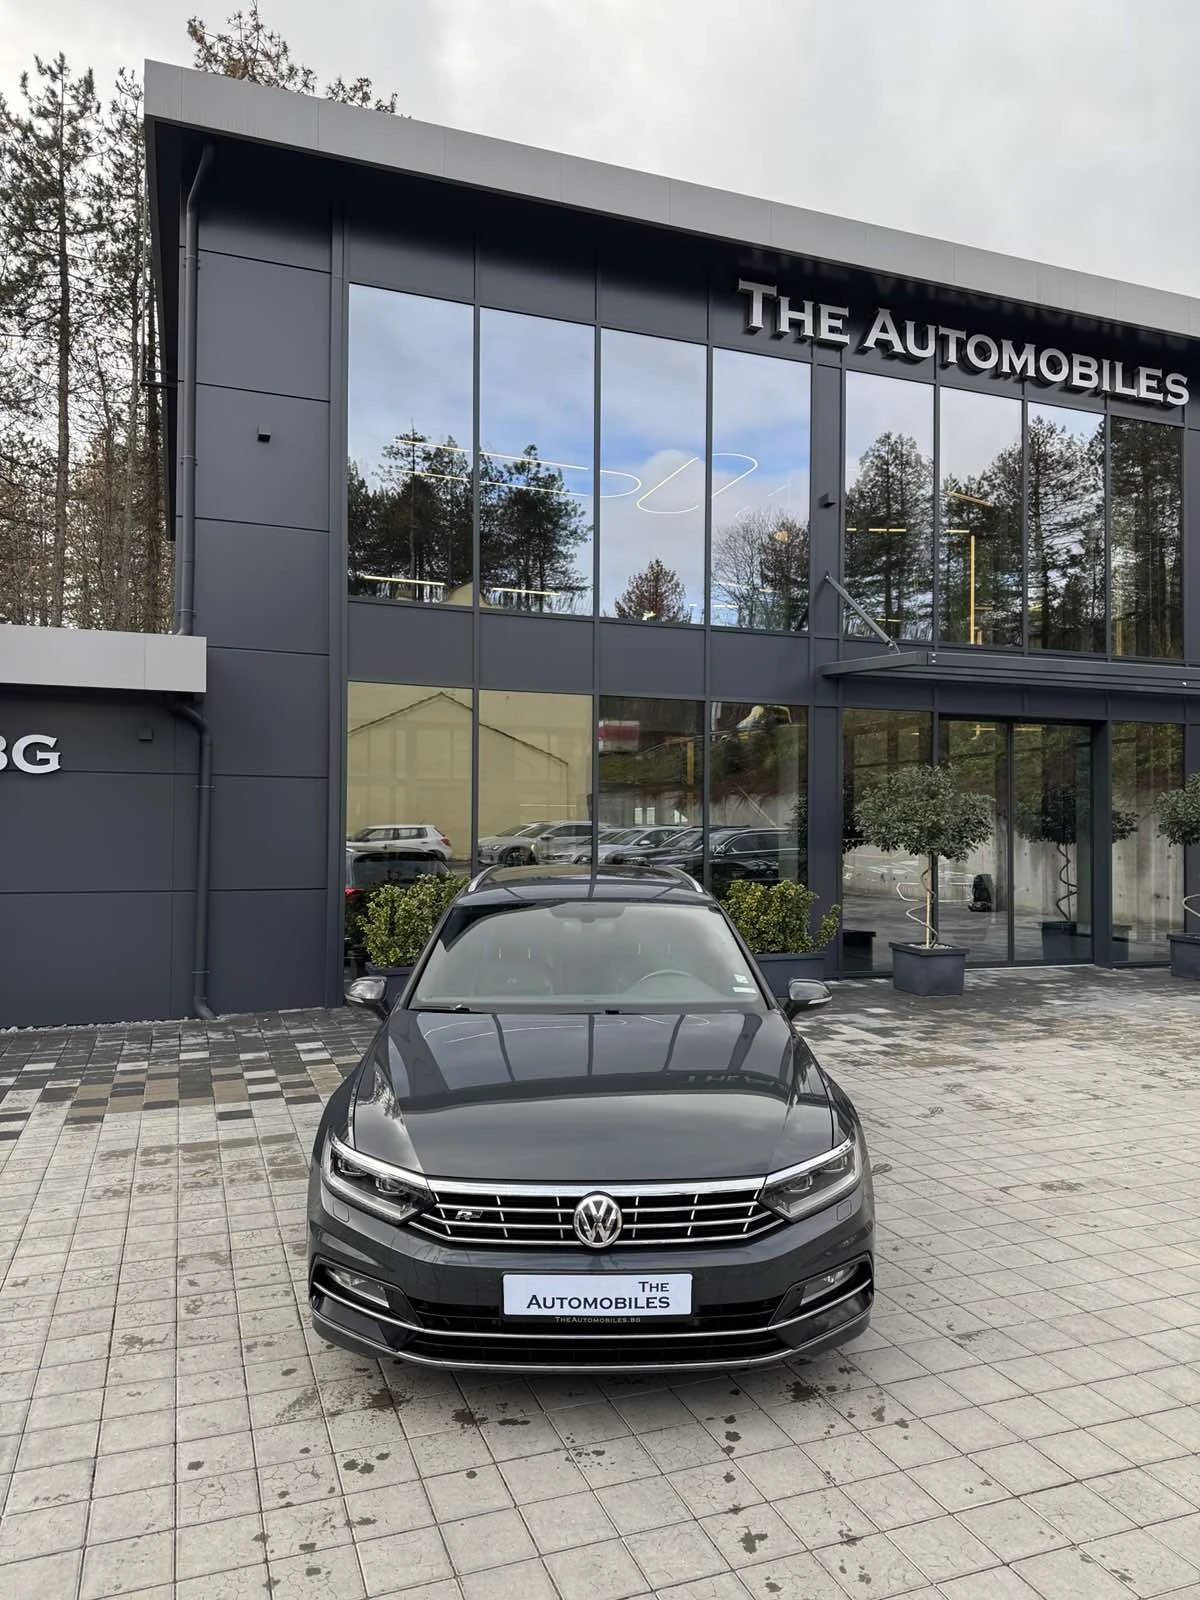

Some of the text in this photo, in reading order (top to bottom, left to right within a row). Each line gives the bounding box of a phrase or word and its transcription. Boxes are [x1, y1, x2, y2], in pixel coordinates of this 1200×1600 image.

[738, 278, 1190, 406] THE AUTOMOBILES
[638, 1281, 670, 1293] THE
[526, 1294, 670, 1310] AUTOMOBILES
